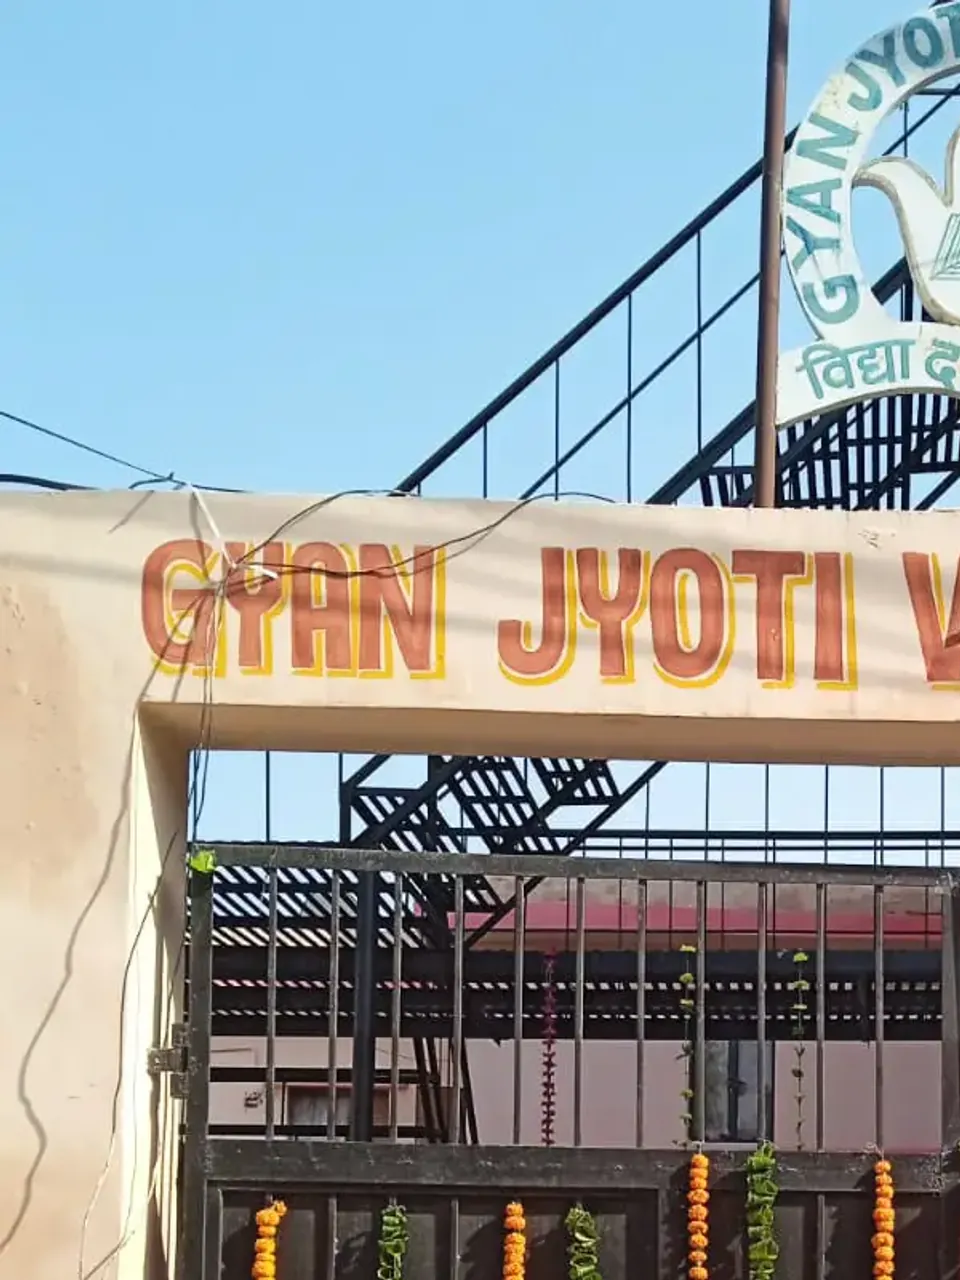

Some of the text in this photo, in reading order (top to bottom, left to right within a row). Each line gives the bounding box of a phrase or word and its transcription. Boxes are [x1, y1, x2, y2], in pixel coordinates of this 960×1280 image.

[785, 111, 862, 324] GYAN
[797, 338, 916, 400] विद्या
[141, 539, 447, 680] GYAN
[497, 546, 859, 690] JYOTI
